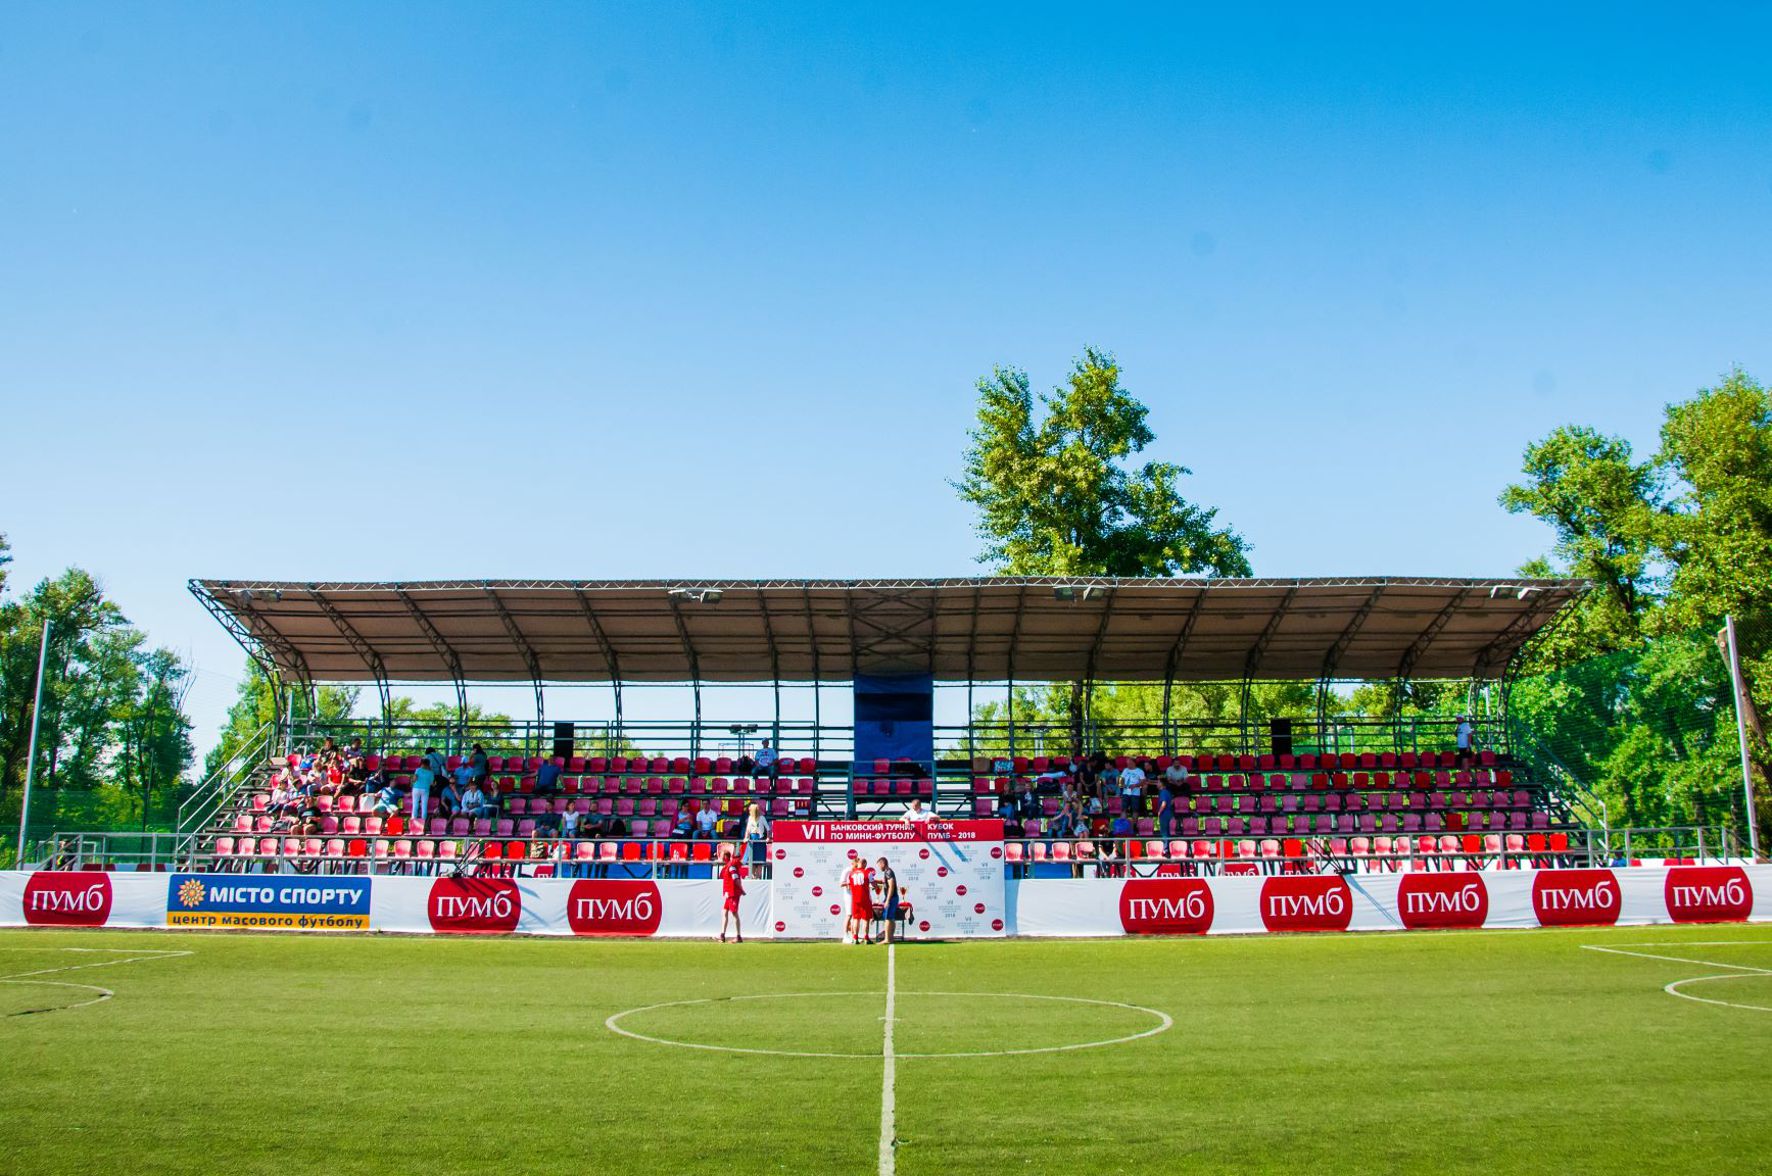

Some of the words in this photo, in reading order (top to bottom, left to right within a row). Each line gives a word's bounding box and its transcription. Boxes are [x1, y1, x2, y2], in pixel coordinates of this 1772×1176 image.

[830, 822, 883, 831] БАНКОВСКИЙ
[927, 822, 954, 831] КУБОК
[801, 824, 825, 840] VII
[830, 832, 844, 840] ПО
[846, 832, 916, 841] МИНИ-ФУТБОЛУ
[958, 831, 976, 839] 2018
[209, 887, 275, 904] МІСТО
[279, 888, 363, 906] СПОРТУ
[173, 914, 217, 926] центр
[221, 914, 295, 927] масового
[297, 914, 366, 928] футболу
